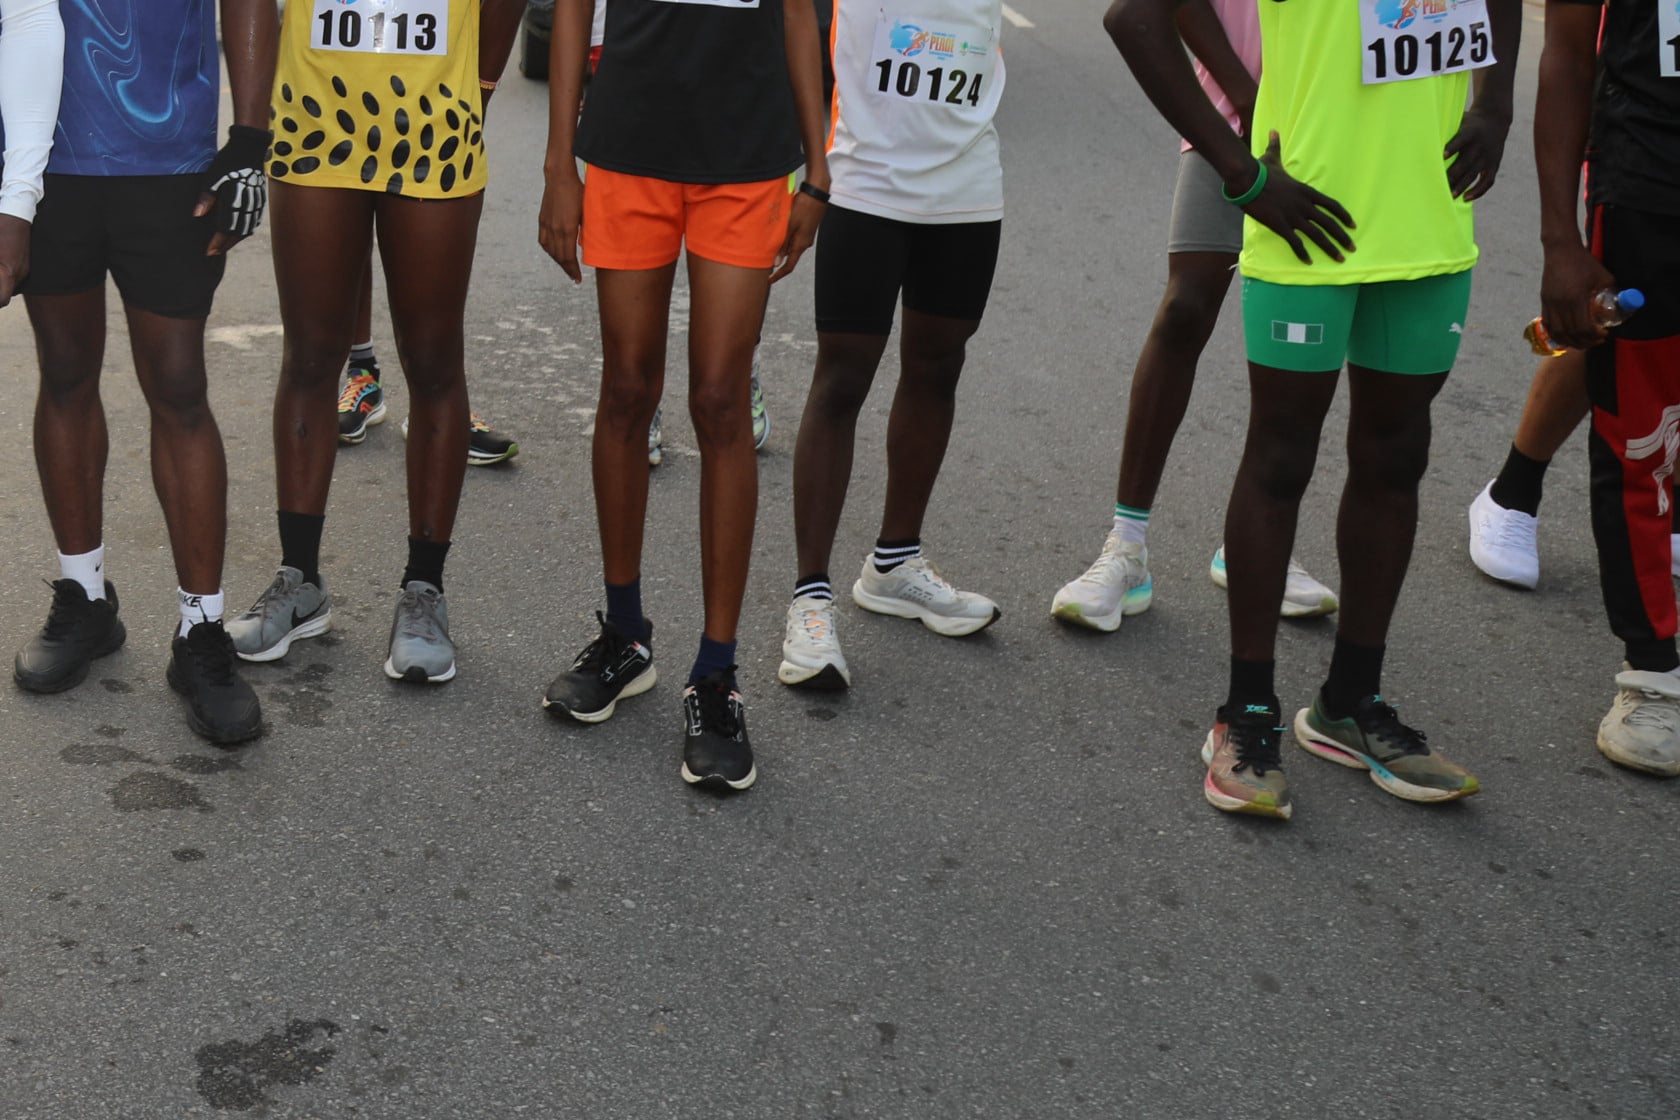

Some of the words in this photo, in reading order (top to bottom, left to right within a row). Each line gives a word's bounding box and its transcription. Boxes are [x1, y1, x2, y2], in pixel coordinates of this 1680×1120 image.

[318, 9, 437, 51] 10113
[1367, 21, 1488, 79] 10125
[875, 58, 983, 107] 10124
